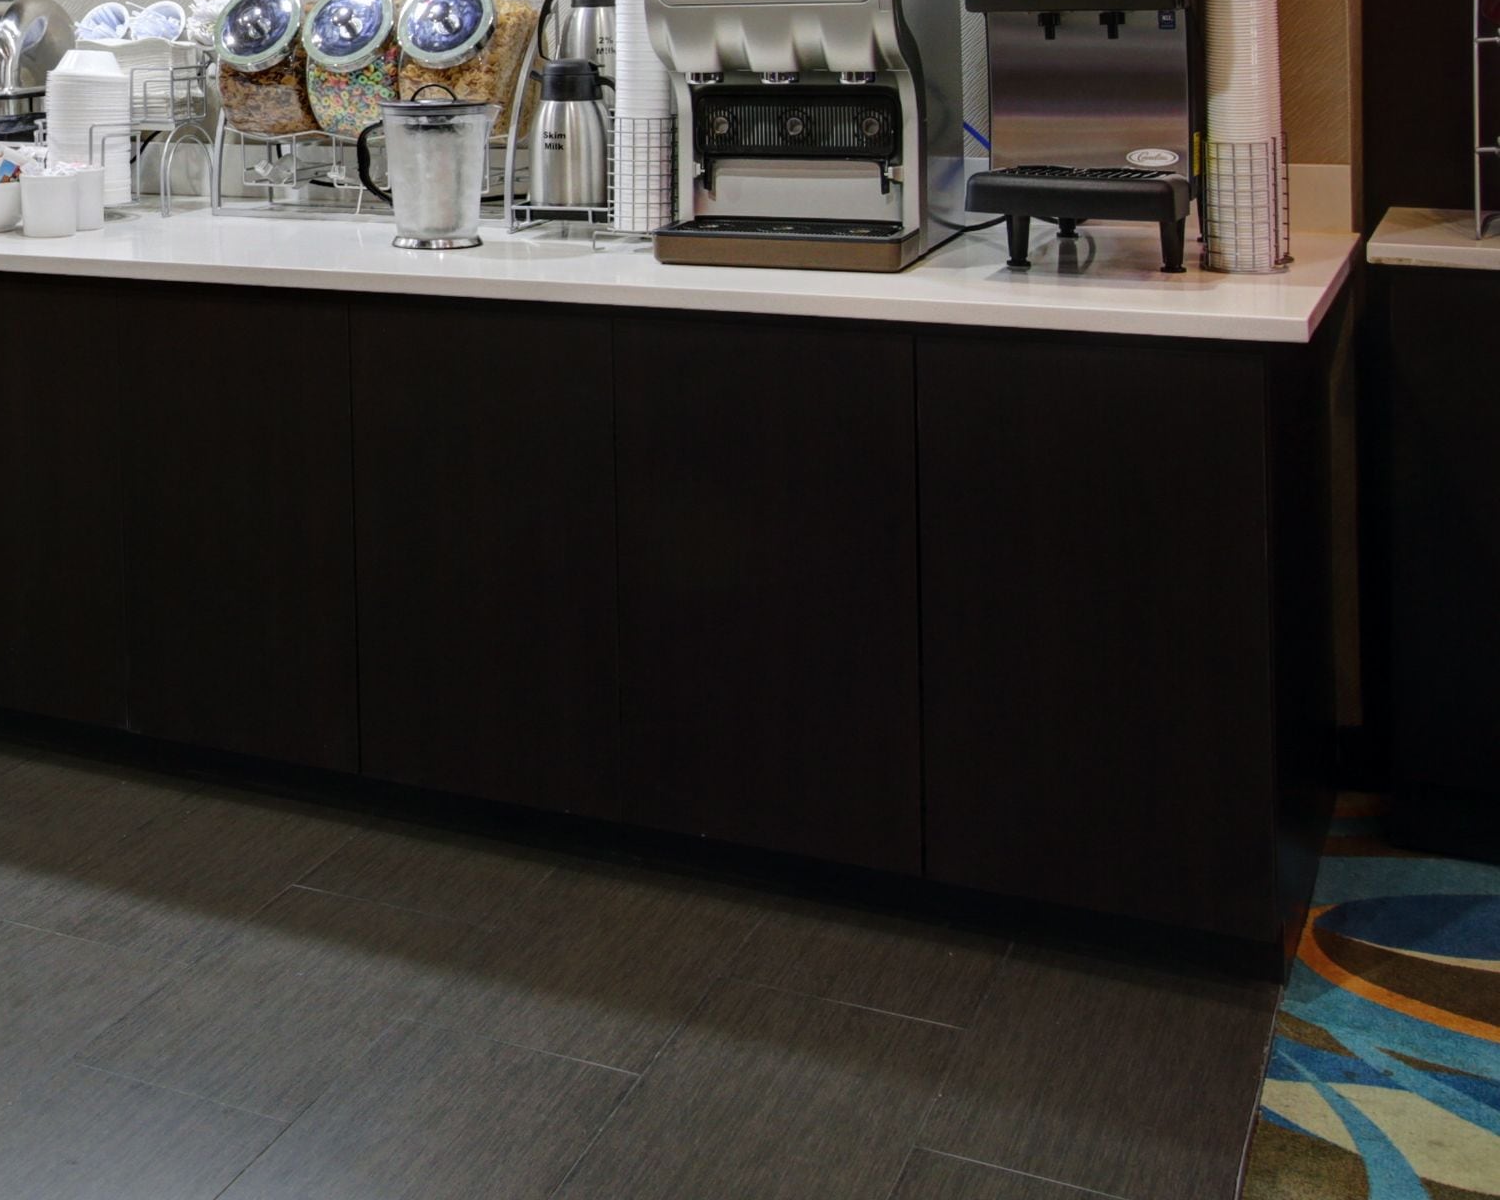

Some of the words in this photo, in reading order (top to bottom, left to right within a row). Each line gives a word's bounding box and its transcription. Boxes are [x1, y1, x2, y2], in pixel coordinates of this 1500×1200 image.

[599, 36, 613, 44] 2%
[543, 131, 566, 139] Skim
[544, 143, 564, 151] Milk
